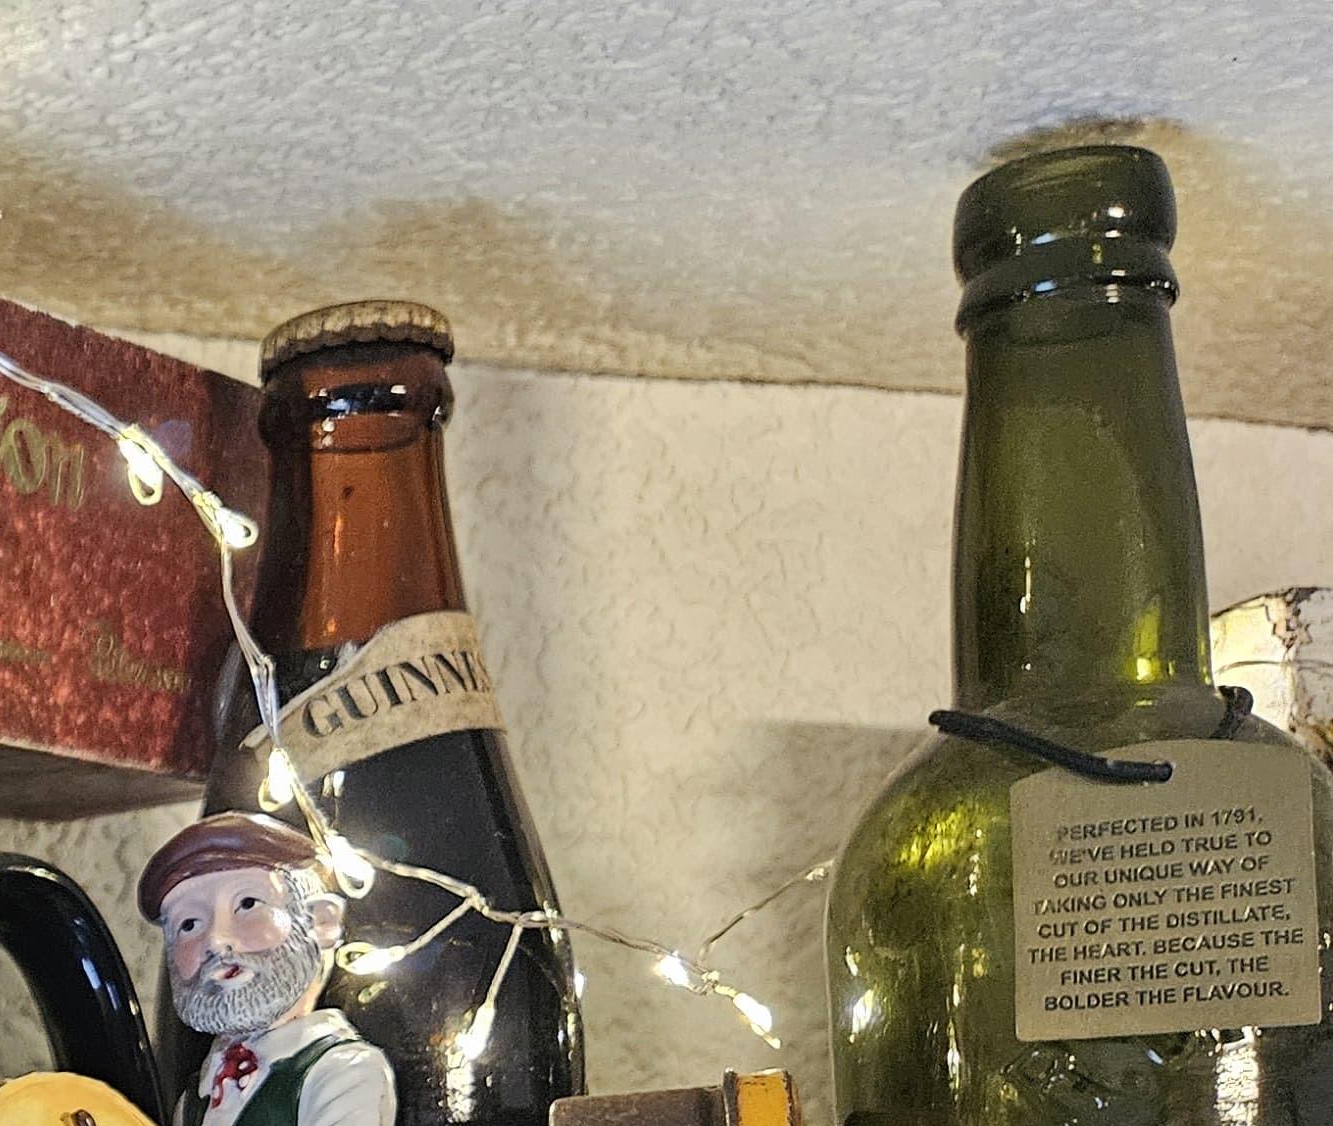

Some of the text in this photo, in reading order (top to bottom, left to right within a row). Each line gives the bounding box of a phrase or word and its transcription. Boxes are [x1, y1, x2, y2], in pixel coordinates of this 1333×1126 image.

[1057, 816, 1178, 842] PERFECTED
[1184, 813, 1205, 829] IN
[1049, 830, 1272, 866] WE'VE HELD TRUE TO
[1053, 855, 1270, 889] OUR UNIQUE WAY OF
[1033, 878, 1296, 916] TAKING ONLY THE FINEST
[1037, 905, 1291, 939] CUT OF THE DISTILLATE,
[1028, 927, 1304, 964] THE HEART. BECAUSE THE
[1060, 955, 1270, 986] FINER THE CUT, THE
[1044, 980, 1290, 1012] BOLDER THE FLAVOUR.
